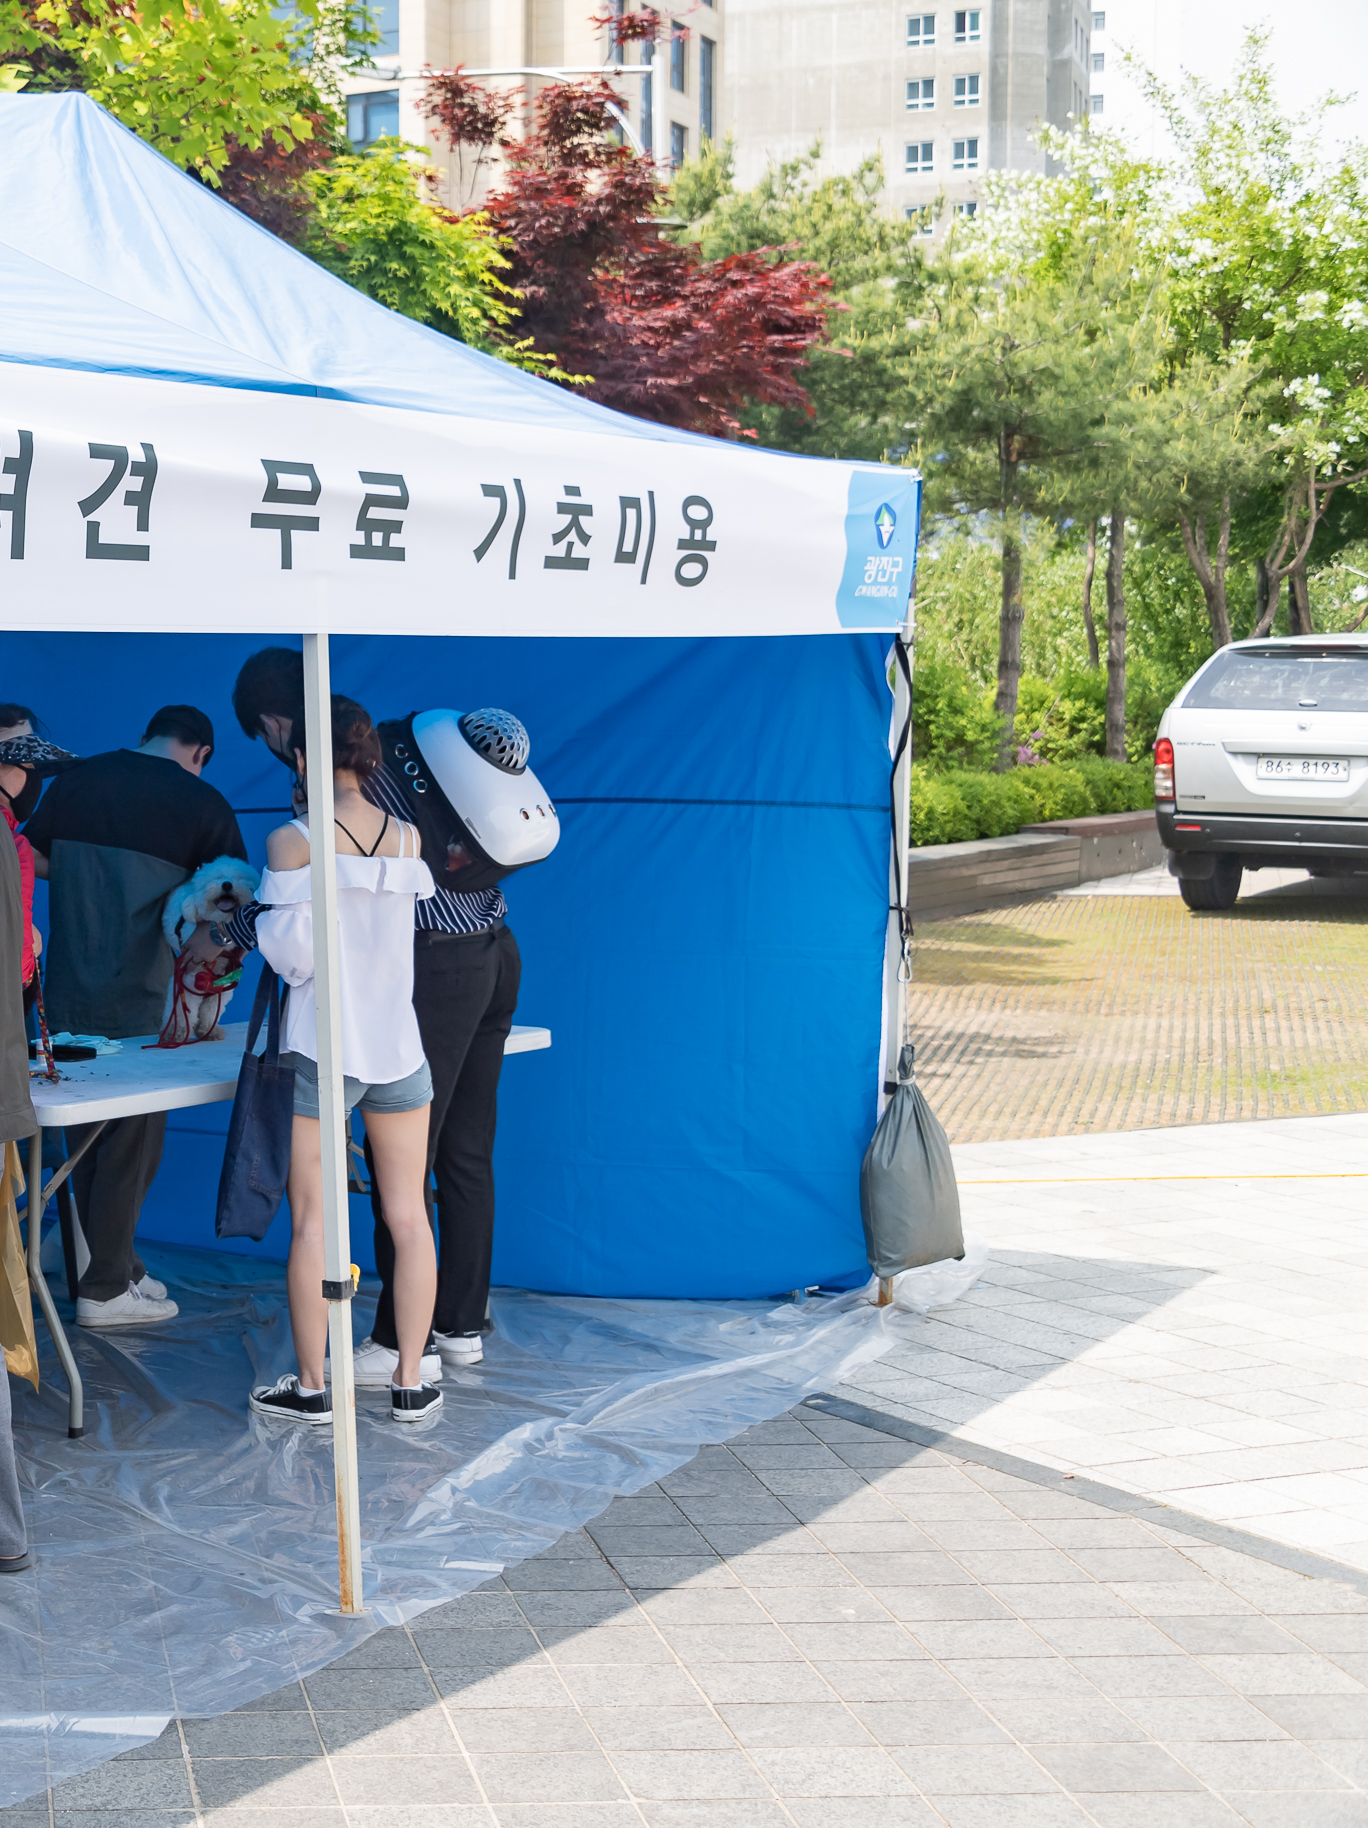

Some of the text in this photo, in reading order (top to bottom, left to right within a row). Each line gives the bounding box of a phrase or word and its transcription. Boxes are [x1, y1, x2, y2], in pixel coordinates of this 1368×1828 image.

[250, 458, 410, 570] 무료
[472, 478, 718, 588] 기초미용
[863, 555, 903, 584] 광진구
[1301, 761, 1341, 776] 8193
